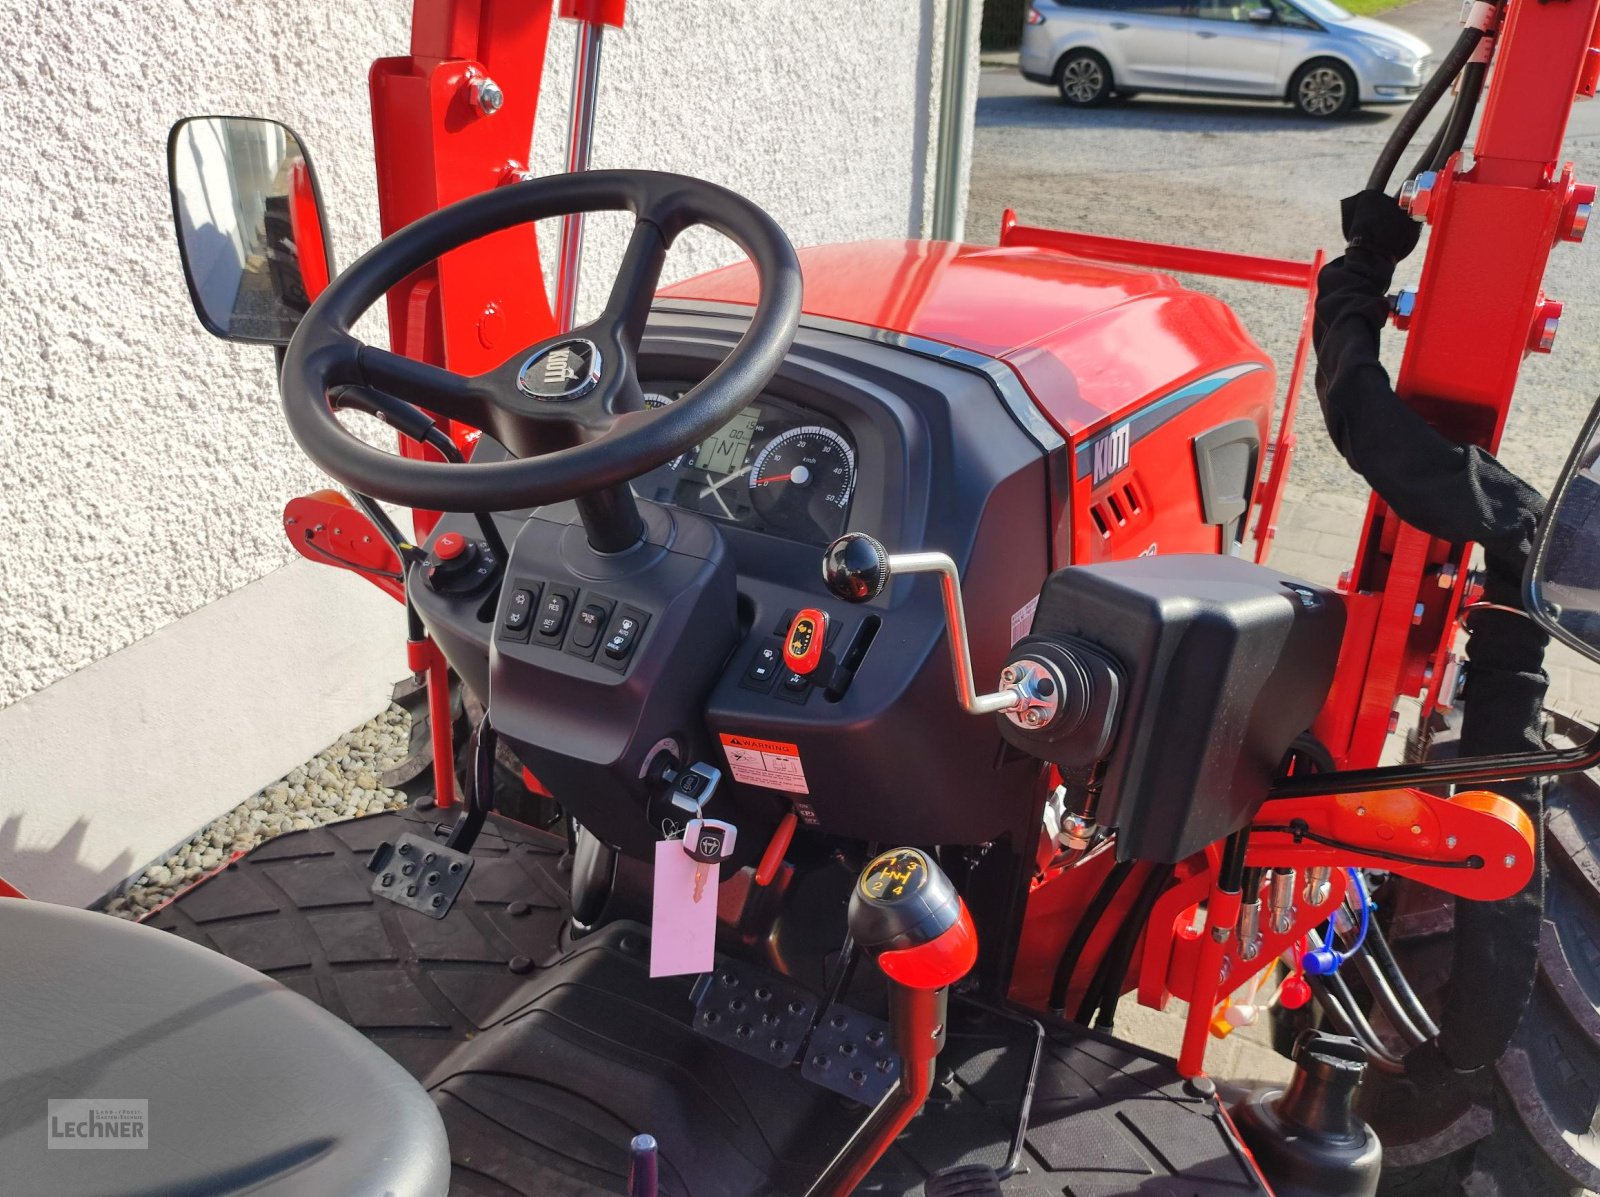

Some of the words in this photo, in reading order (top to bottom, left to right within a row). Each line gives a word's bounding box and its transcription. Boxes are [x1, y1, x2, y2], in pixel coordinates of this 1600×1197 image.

[544, 350, 570, 383] KIOTI
[1093, 422, 1130, 486] KIOTI
[743, 739, 790, 752] WARNING
[907, 861, 918, 870] 3
[872, 881, 883, 891] 2
[893, 886, 904, 895] 4
